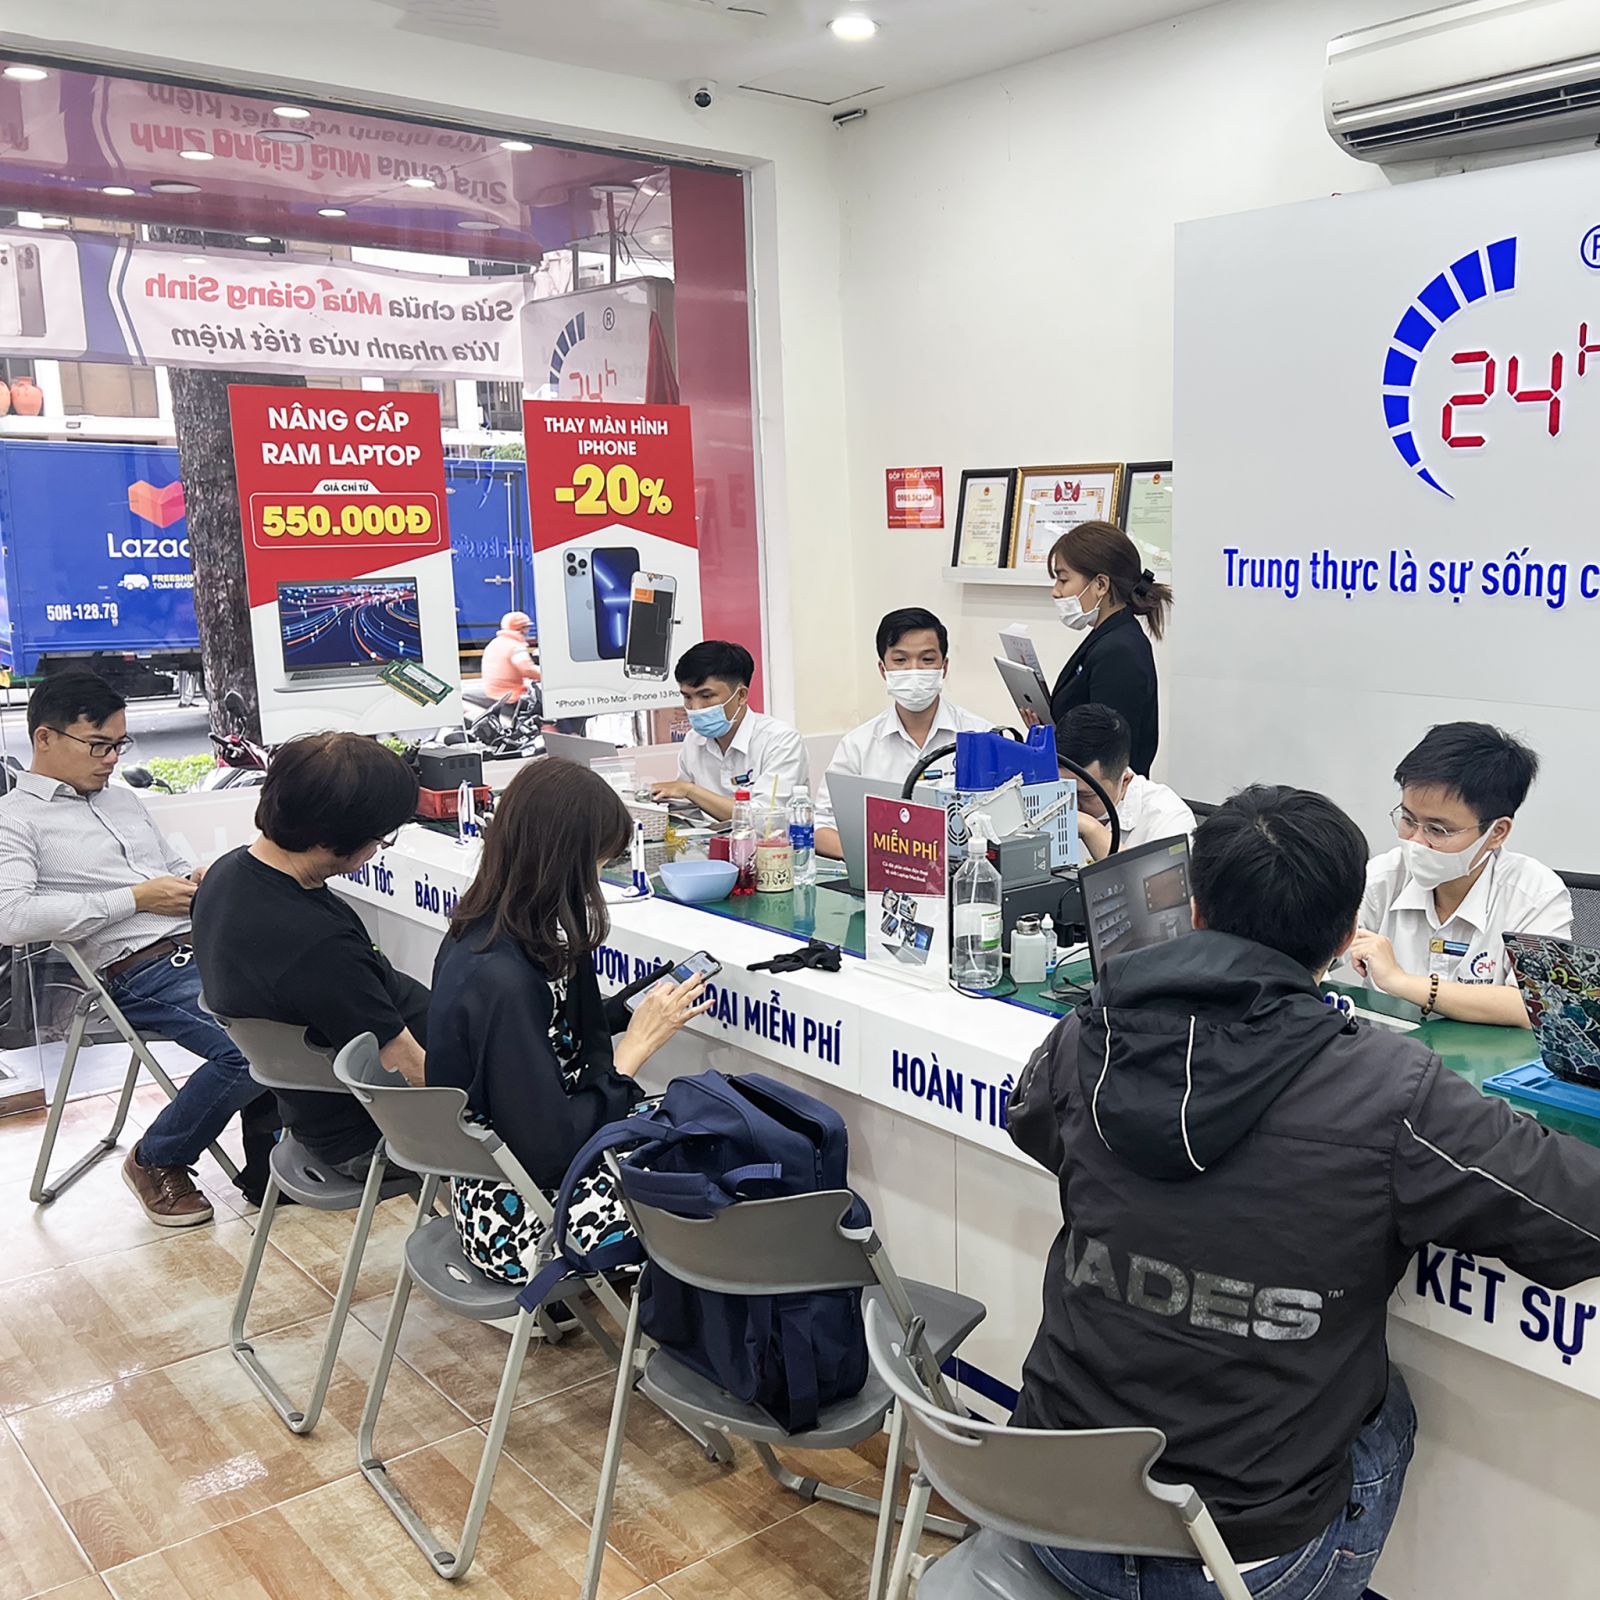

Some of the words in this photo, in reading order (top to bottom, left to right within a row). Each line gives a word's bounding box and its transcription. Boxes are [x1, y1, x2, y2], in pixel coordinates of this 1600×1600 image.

[267, 402, 349, 431] NÂNG
[355, 401, 410, 433] CẤP
[543, 416, 586, 434] THAY
[589, 414, 627, 435] MÀN
[630, 416, 669, 436] HÌNH
[261, 442, 321, 465] RAM
[328, 443, 422, 467] LAPTOP
[578, 439, 637, 456] IPHONE
[323, 482, 340, 492] GIÁ
[554, 462, 673, 516] -20%
[261, 503, 432, 538] 550.000Đ
[1222, 548, 1300, 599] Trung
[1309, 549, 1379, 600] thực
[1389, 549, 1417, 593] là
[1428, 560, 1474, 604] sự
[1481, 546, 1567, 610] sống
[873, 828, 909, 856] MIỄN
[912, 840, 939, 862] PHÍ
[372, 855, 395, 897] TỐC
[415, 873, 440, 914] BẢO
[593, 945, 629, 987] ƯỢN
[744, 989, 796, 1049] MIỄN
[803, 1016, 842, 1066] PHÍ
[892, 1049, 963, 1114] HOÀN
[970, 1073, 1015, 1131] TIỀ
[1065, 1230, 1323, 1341] ADES
[1519, 1285, 1597, 1366] SỰ
